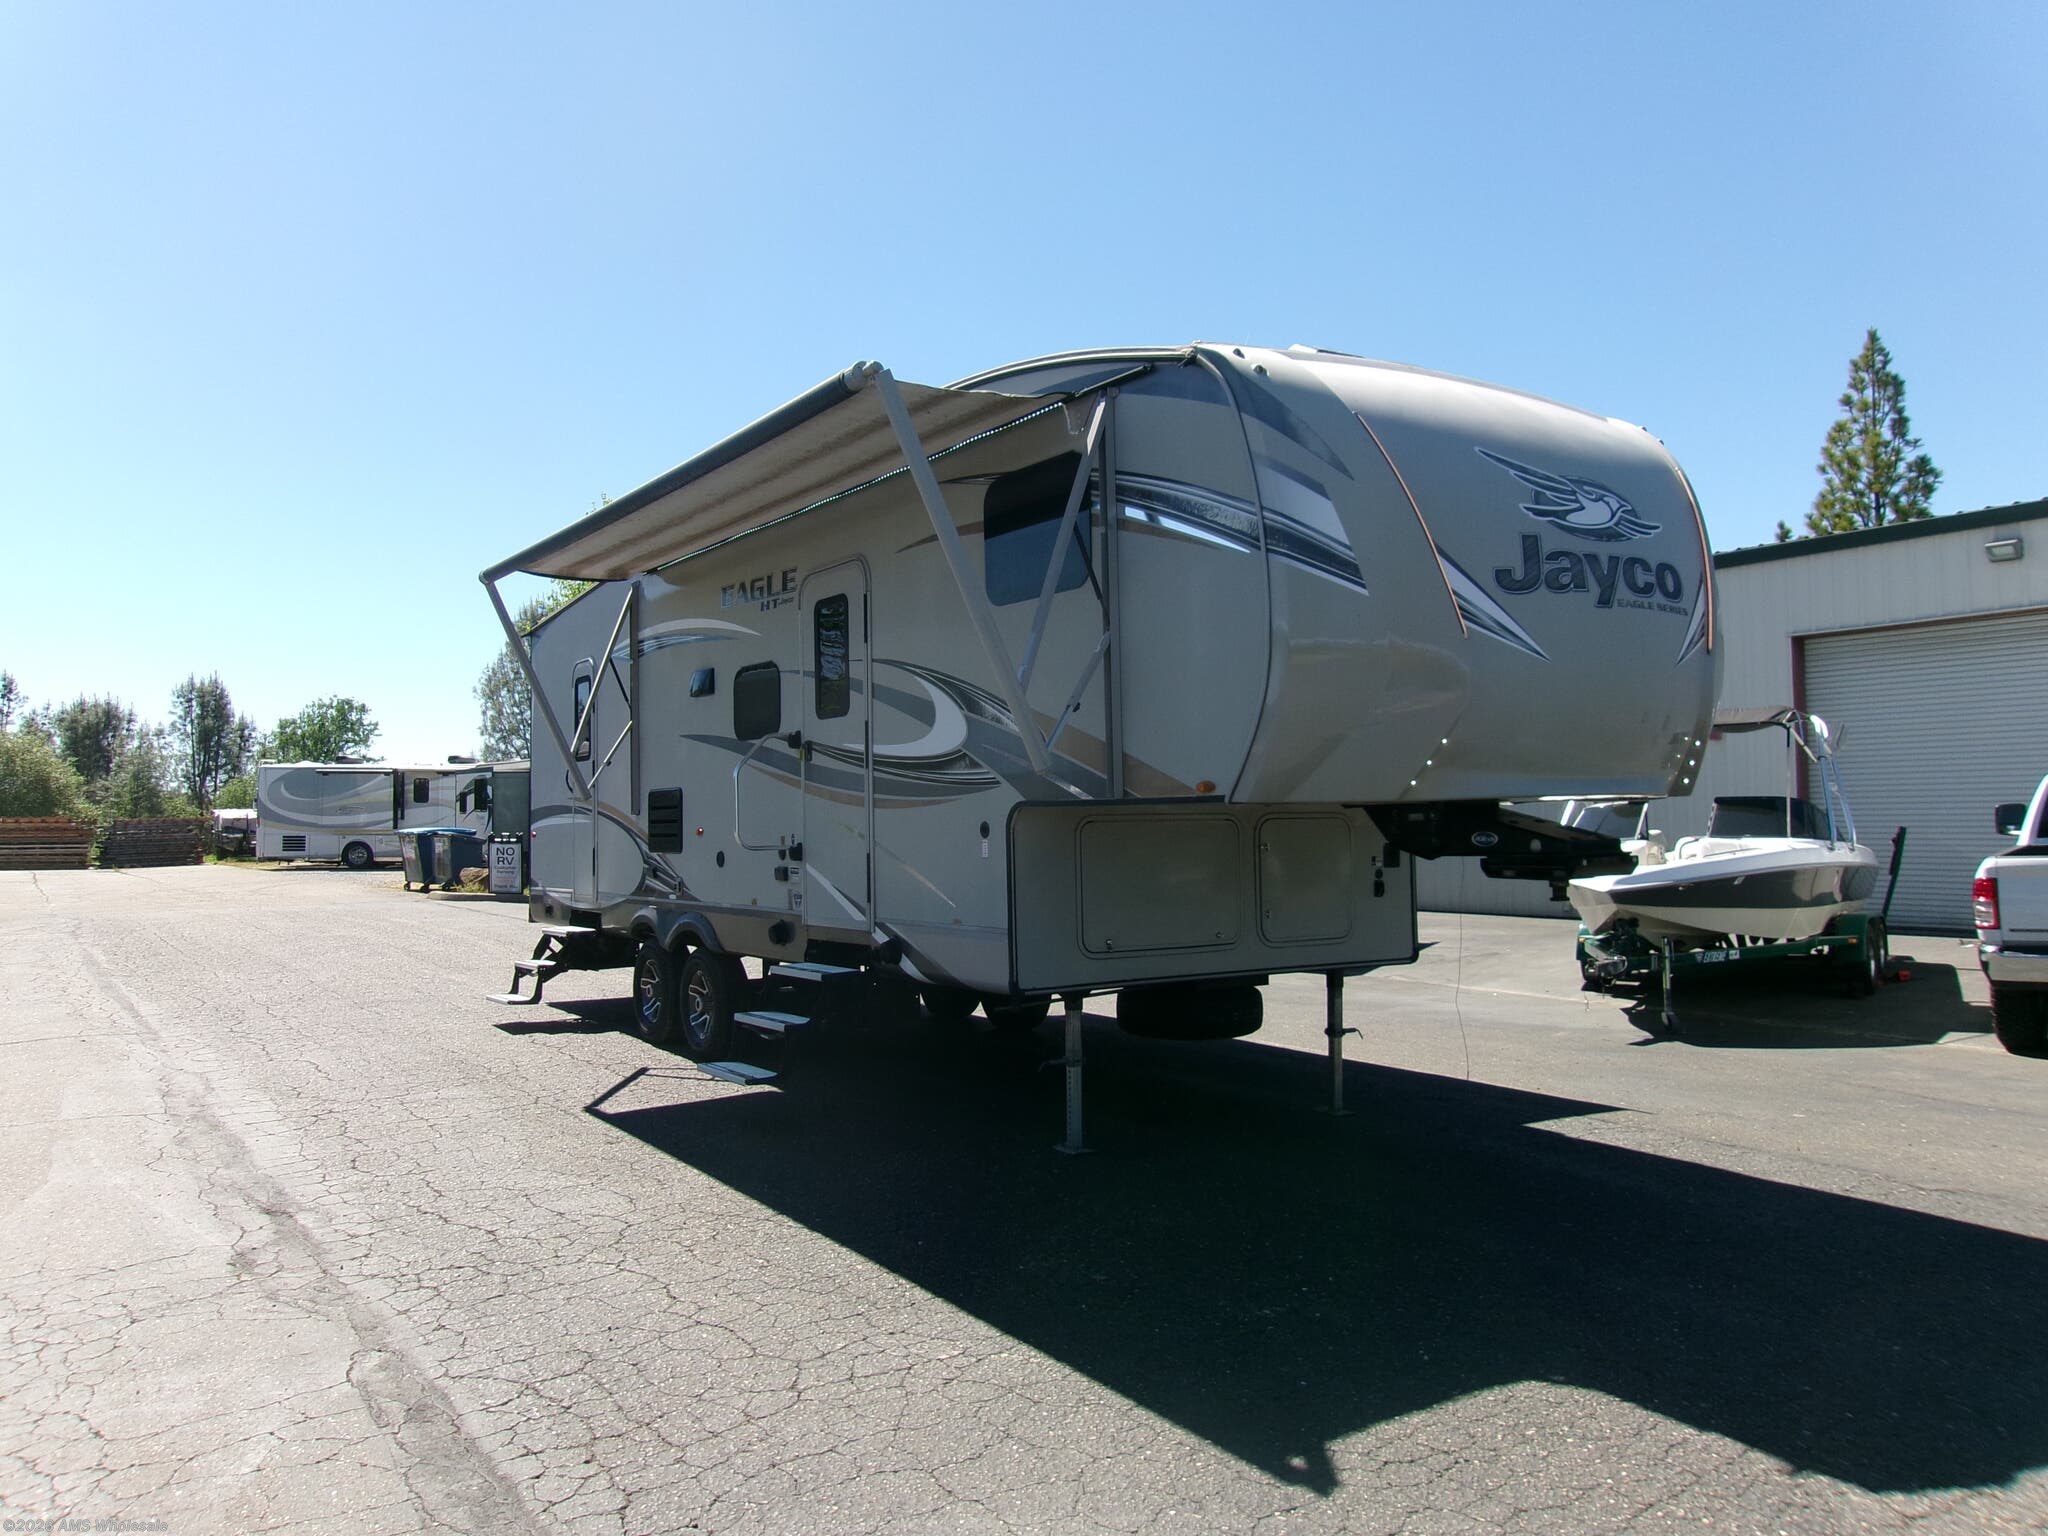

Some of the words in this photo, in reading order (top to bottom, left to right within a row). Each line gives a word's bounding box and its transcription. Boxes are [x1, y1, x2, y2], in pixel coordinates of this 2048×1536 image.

[1493, 531, 1683, 608] Jayco
[721, 567, 798, 609] EAGLE
[760, 599, 780, 611] HT
[1617, 598, 1655, 610] EAGLE
[1657, 602, 1689, 616] SERIES
[496, 847, 515, 856] NO
[497, 856, 514, 865] RV
